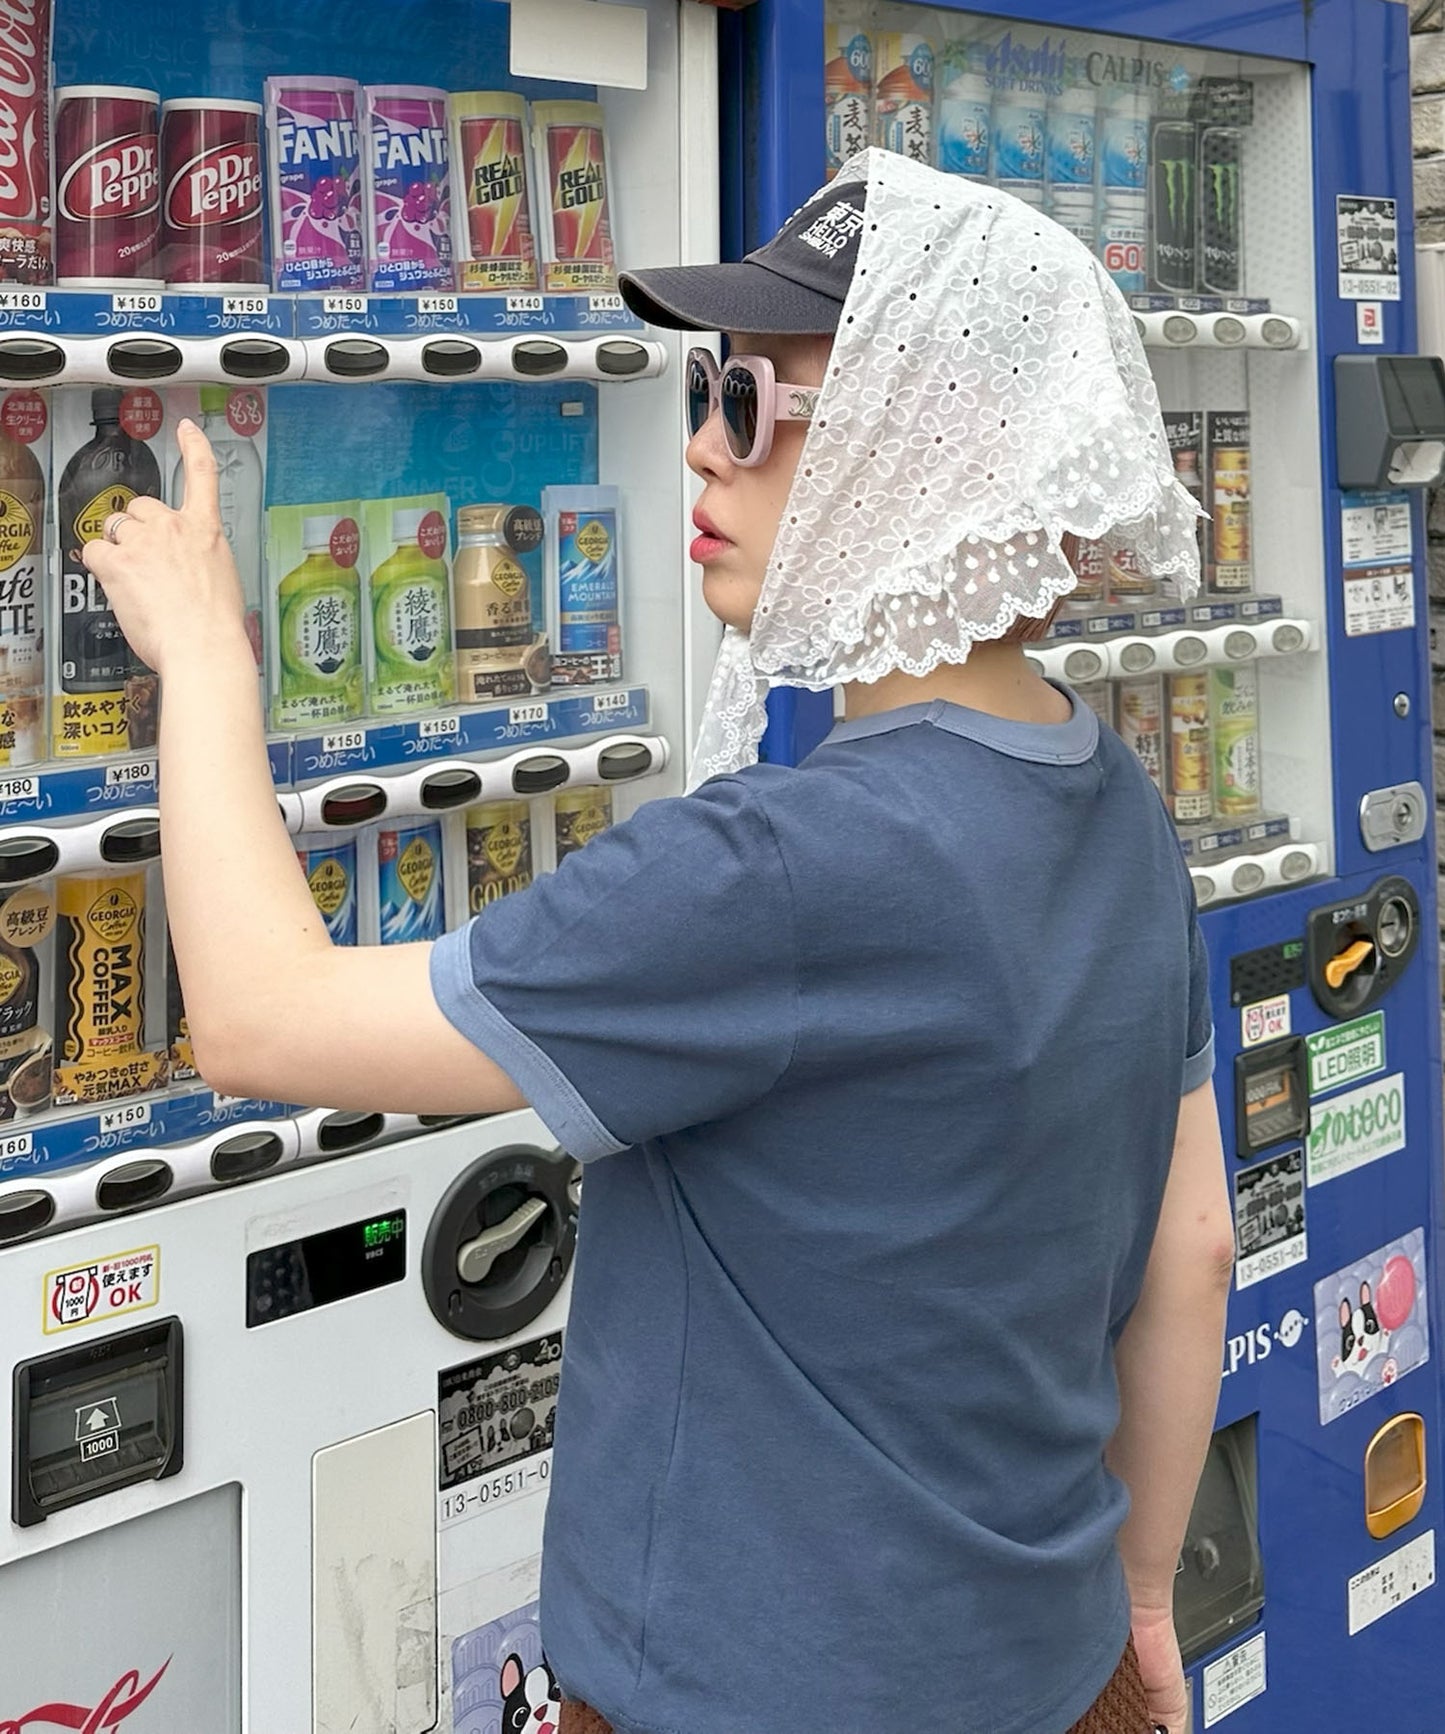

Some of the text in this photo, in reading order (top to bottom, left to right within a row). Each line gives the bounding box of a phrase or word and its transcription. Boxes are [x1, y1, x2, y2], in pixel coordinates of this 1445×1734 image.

[1085, 51, 1165, 88] CALPIS
[121, 145, 154, 178] Dr
[218, 155, 253, 187] Dr
[474, 154, 523, 186] REAL
[280, 173, 304, 184] grape
[375, 178, 398, 188] grape
[560, 160, 603, 190] REAL
[818, 201, 864, 238] 東京
[808, 220, 848, 249] HELLO
[285, 257, 334, 273] ひと口目から
[117, 296, 157, 310] ¥150
[227, 299, 264, 312] ¥150
[328, 299, 362, 311] ¥150
[422, 299, 454, 311] ¥150
[510, 297, 540, 309] ¥140
[593, 296, 621, 308] ¥140
[6, 414, 44, 426] 生クリーム
[229, 399, 262, 425] もも
[312, 597, 342, 657] 綾鷹
[403, 587, 432, 645] 綾鷹
[63, 695, 141, 720] 飲みやすく
[597, 693, 625, 707] ¥140
[512, 706, 543, 720] ¥170
[63, 719, 129, 741] 深いコク
[423, 718, 457, 733] ¥150
[327, 733, 362, 748] ¥150
[112, 763, 150, 782] ¥180
[6, 904, 50, 927] 高級豆
[90, 907, 135, 921] GEORGIA
[7, 921, 47, 938] ブレンド
[93, 947, 109, 1027] COFFEE
[111, 943, 132, 1025] MAX
[87, 1041, 136, 1058] コーヒー飲料
[1317, 1041, 1376, 1081] LED照明
[74, 1061, 150, 1085] やみつきの甘さ
[83, 1074, 143, 1097] 元気MAX
[104, 1105, 145, 1128] ¥150
[365, 1217, 404, 1248] 販売中
[102, 1263, 153, 1288] 使えます
[65, 1295, 85, 1308] 1000
[110, 1281, 142, 1307] OK
[70, 1308, 79, 1317] 円
[1222, 1323, 1272, 1377] PIS
[86, 1437, 113, 1455] 1000
